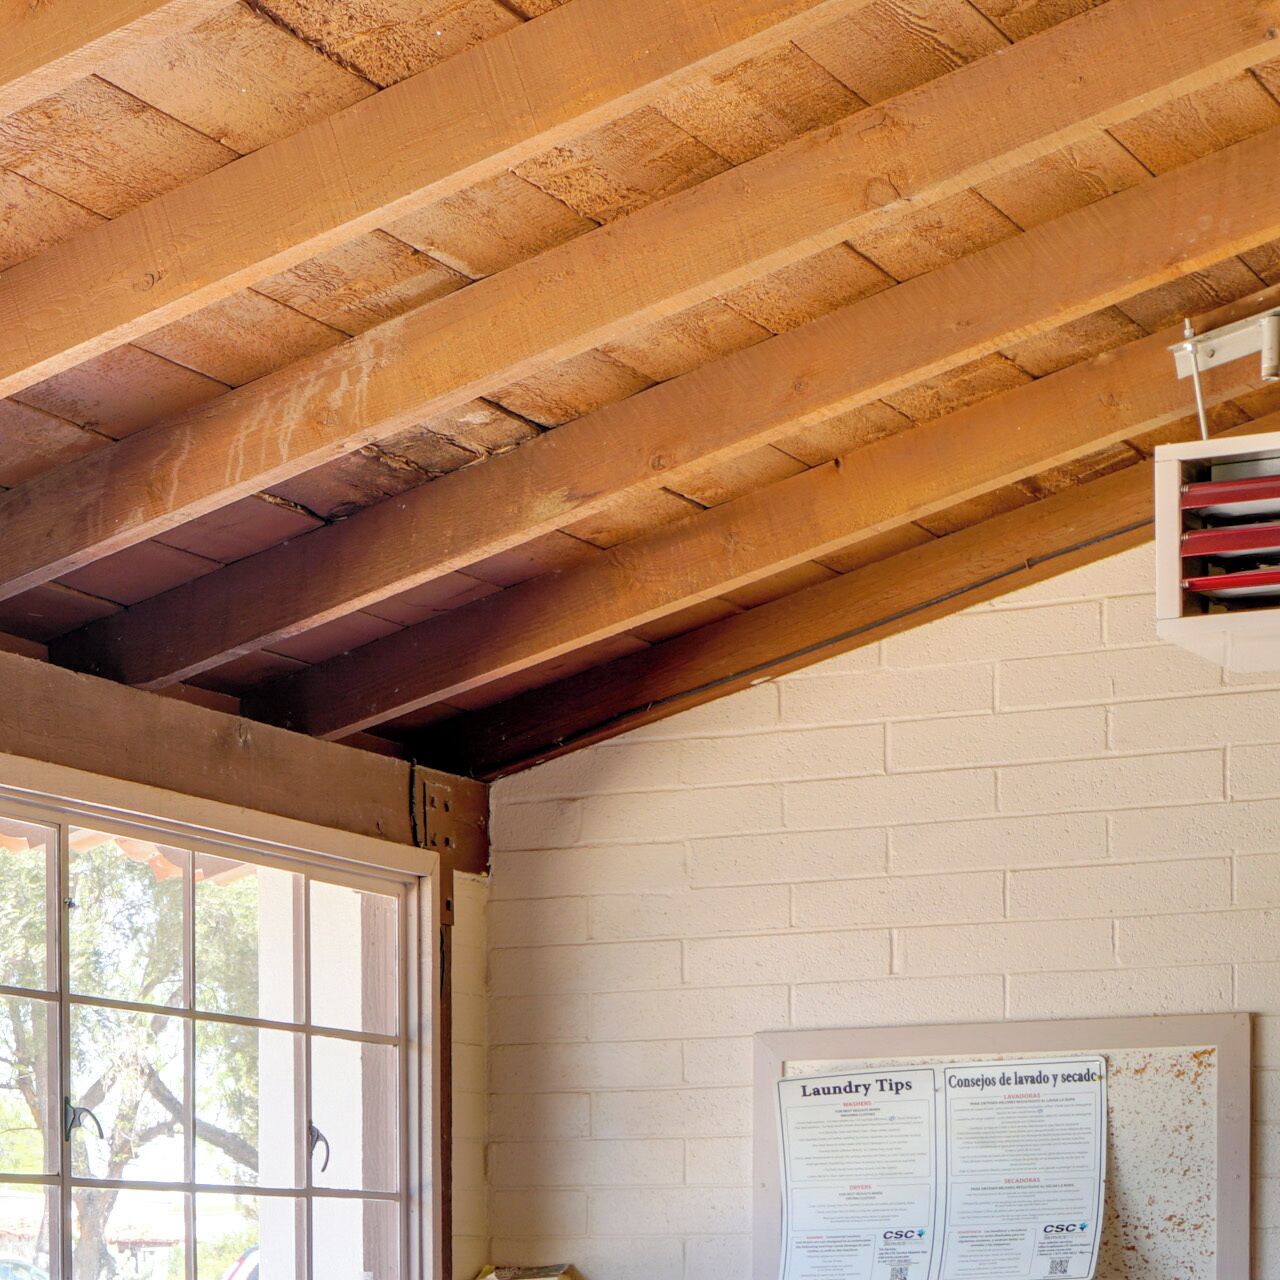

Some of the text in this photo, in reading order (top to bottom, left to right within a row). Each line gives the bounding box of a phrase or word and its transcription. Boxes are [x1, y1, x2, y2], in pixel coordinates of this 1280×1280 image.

[801, 1078, 912, 1097] Laundry Tips
[948, 1074, 996, 1091] Consejos
[1002, 1071, 1012, 1086] de
[1014, 1070, 1050, 1085] lavado
[1052, 1073, 1059, 1087] y
[883, 1230, 915, 1240] CSC
[1043, 1224, 1077, 1233] CSC
